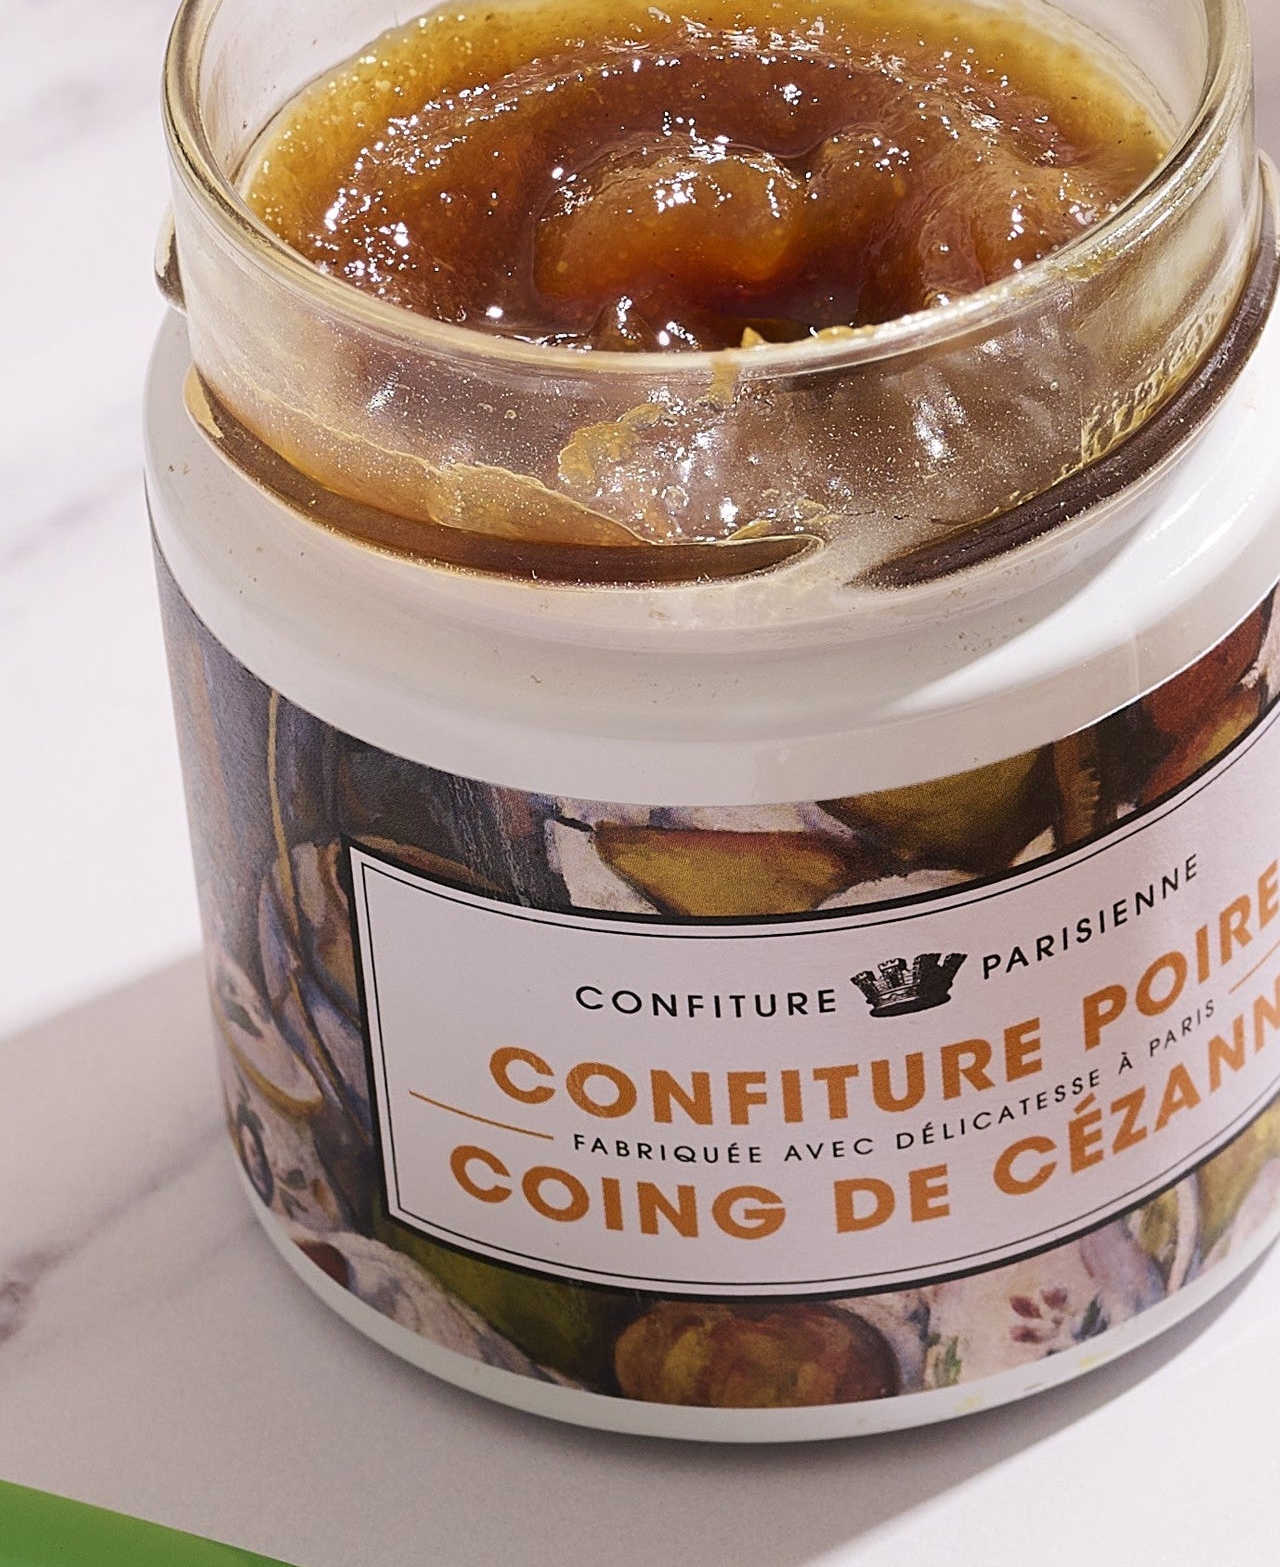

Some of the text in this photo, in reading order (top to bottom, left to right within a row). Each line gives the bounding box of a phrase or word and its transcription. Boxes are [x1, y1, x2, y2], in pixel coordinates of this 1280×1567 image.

[490, 859, 1280, 1125] CONFITURE POIRE
[575, 853, 1197, 1019] CONFITURE PARISIENNE
[573, 999, 1214, 1164] FABRIQUÉE AVEC DÉLICATESSE À PARIS
[450, 1145, 785, 1239] COING
[834, 1165, 949, 1233] DE
